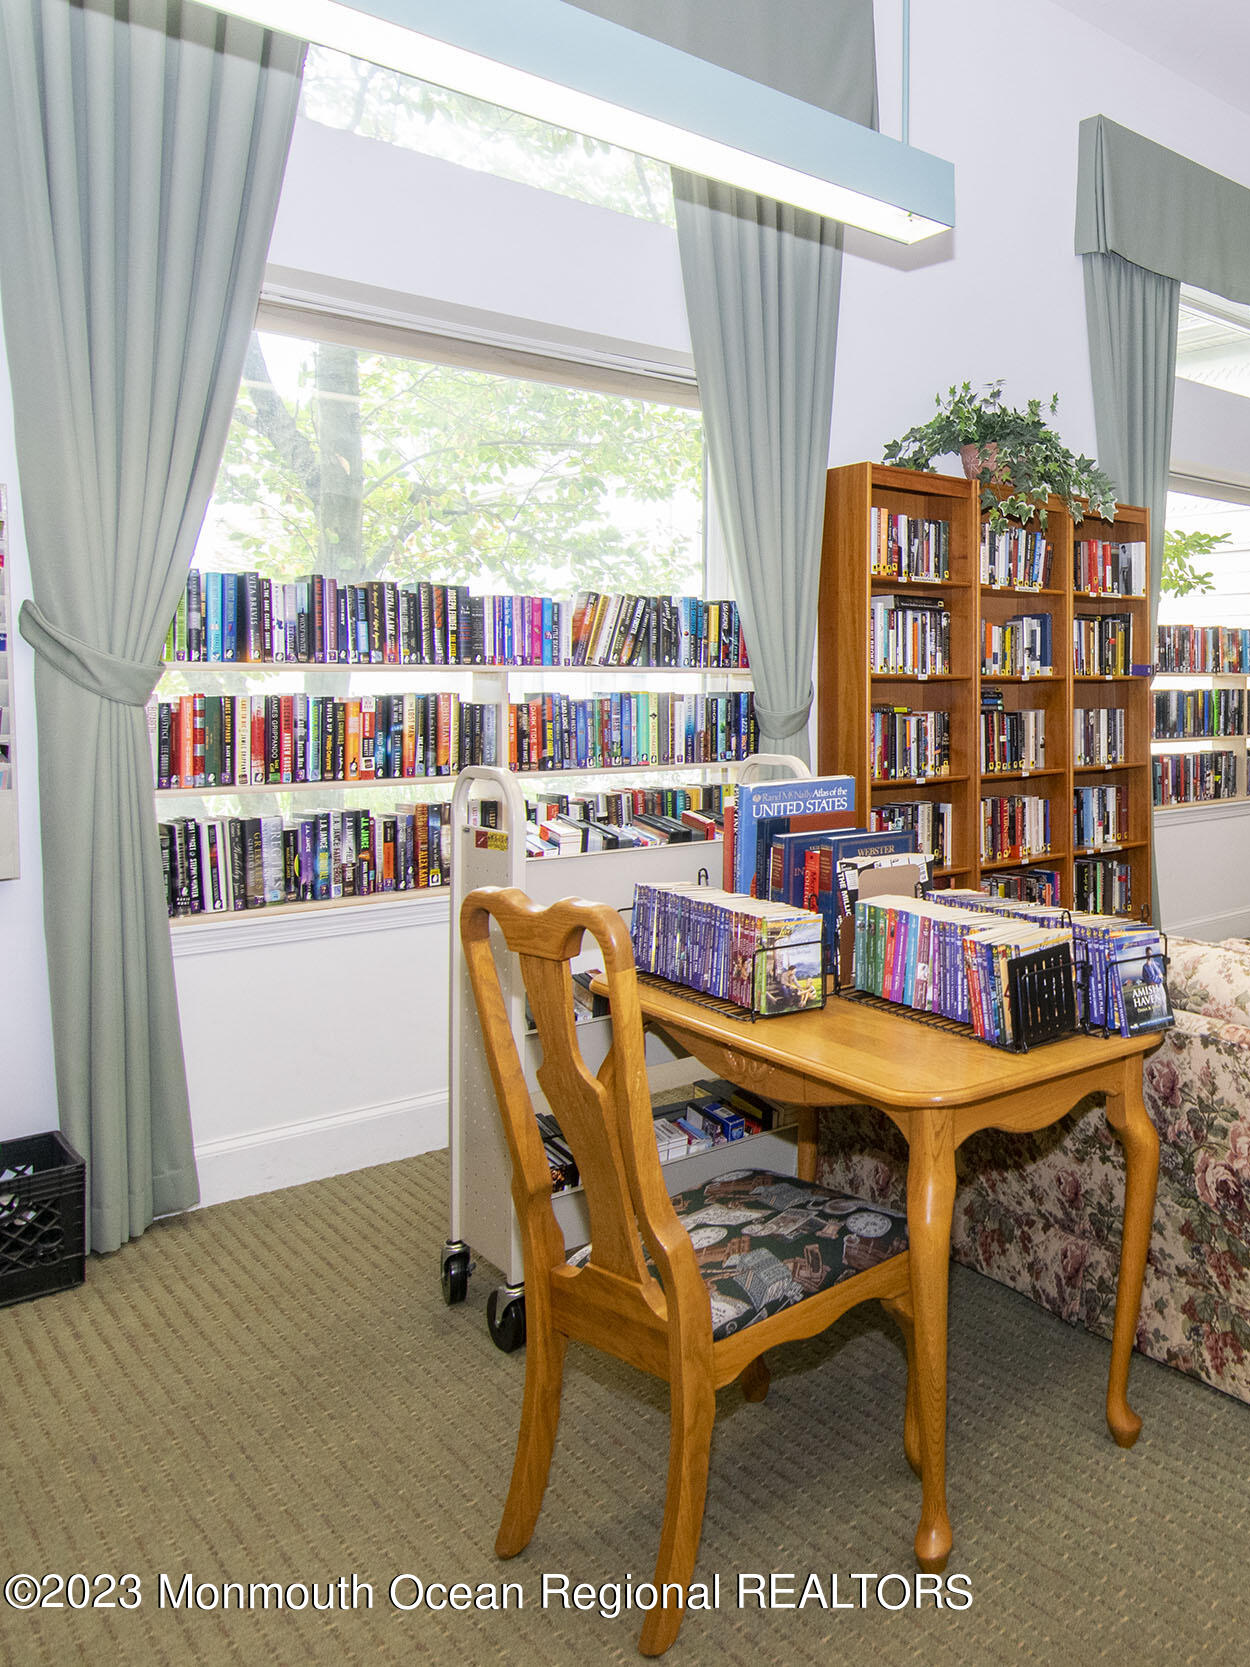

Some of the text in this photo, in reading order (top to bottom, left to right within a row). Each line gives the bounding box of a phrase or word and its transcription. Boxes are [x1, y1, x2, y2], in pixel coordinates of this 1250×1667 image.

[248, 575, 258, 625] VITA BREVIS
[448, 589, 457, 610] JOSEPH
[386, 589, 396, 635] FATAL FLAME
[448, 610, 457, 631] FINDER
[552, 640, 560, 656] DEATHS
[561, 699, 569, 714] DEAD
[160, 706, 169, 739] INJUSTICE
[224, 715, 232, 743] GRIPPANDO
[271, 696, 280, 759] JAMES GRIPPANDO
[407, 708, 416, 738] LOST MAN
[441, 701, 450, 746] JOHN HART
[529, 706, 538, 743] DARK TIDE
[561, 714, 569, 730] LIONS
[376, 731, 384, 745] KIND
[282, 732, 292, 774] ANDREW GROSS
[376, 750, 384, 768] CRUEL
[762, 790, 781, 803] Rand
[811, 788, 829, 799] Atlas
[829, 787, 838, 797] of
[838, 786, 848, 796] the
[752, 796, 848, 819] UNITED STATES
[318, 819, 328, 831] J.A.
[345, 817, 354, 830] J.A.
[360, 816, 370, 829] J.A.
[319, 830, 328, 850] JANCE
[332, 815, 341, 866] J.A. JANCE FATAL
[360, 829, 370, 849] JANCE
[253, 831, 263, 890] GREG ILES
[269, 821, 283, 889] GREG ILES
[418, 850, 428, 867] ALEX
[857, 844, 896, 858] WEBSTER
[418, 868, 428, 887] KAVA
[837, 871, 848, 890] THE
[190, 879, 200, 899] HUNTER
[1132, 983, 1161, 999] AMISH
